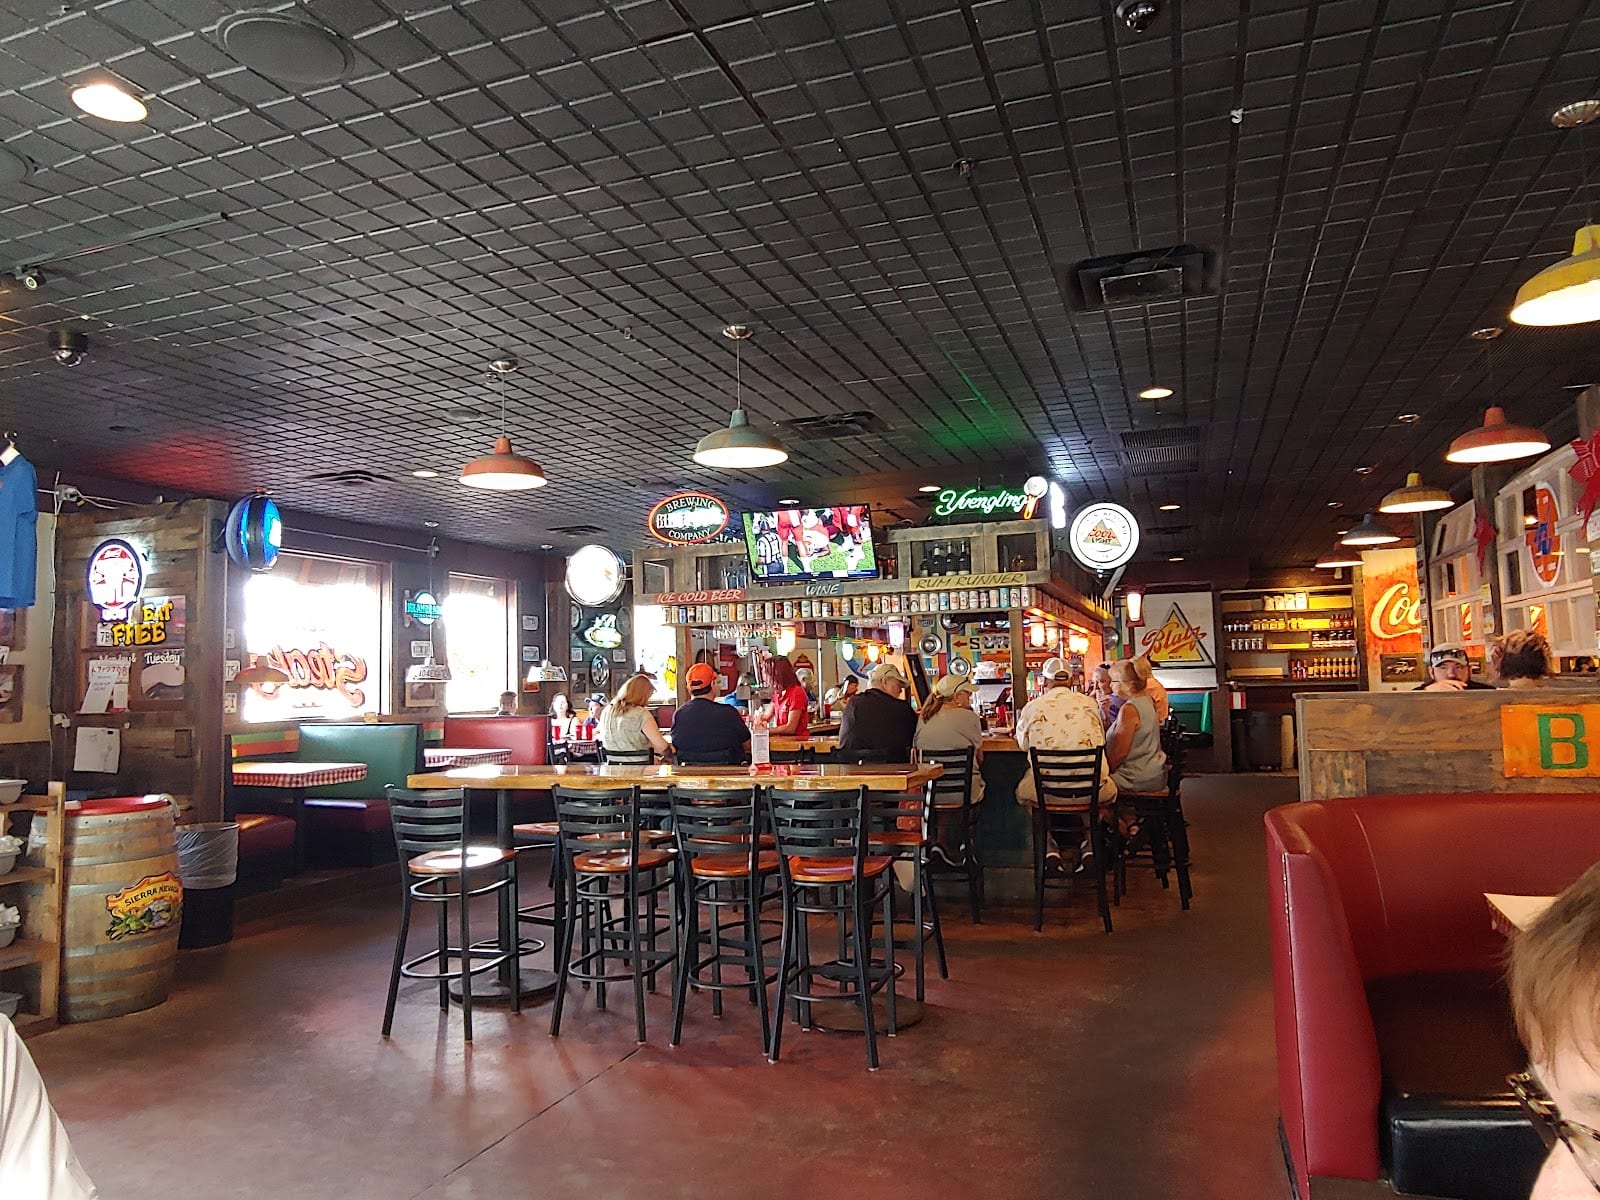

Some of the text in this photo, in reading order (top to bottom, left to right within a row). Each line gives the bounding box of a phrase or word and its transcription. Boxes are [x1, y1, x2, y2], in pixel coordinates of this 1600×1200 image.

[665, 497, 716, 512] BREWING
[668, 529, 711, 541] COMPANY
[915, 573, 1023, 589] RUM RUNNER
[657, 589, 742, 603] ICE COLD BEER
[805, 584, 840, 596] WINE
[142, 600, 174, 621] EAT
[1141, 622, 1207, 657] Blatz
[144, 651, 181, 666] Tuesday
[1537, 713, 1590, 770] B
[124, 888, 158, 906] SIERRA
